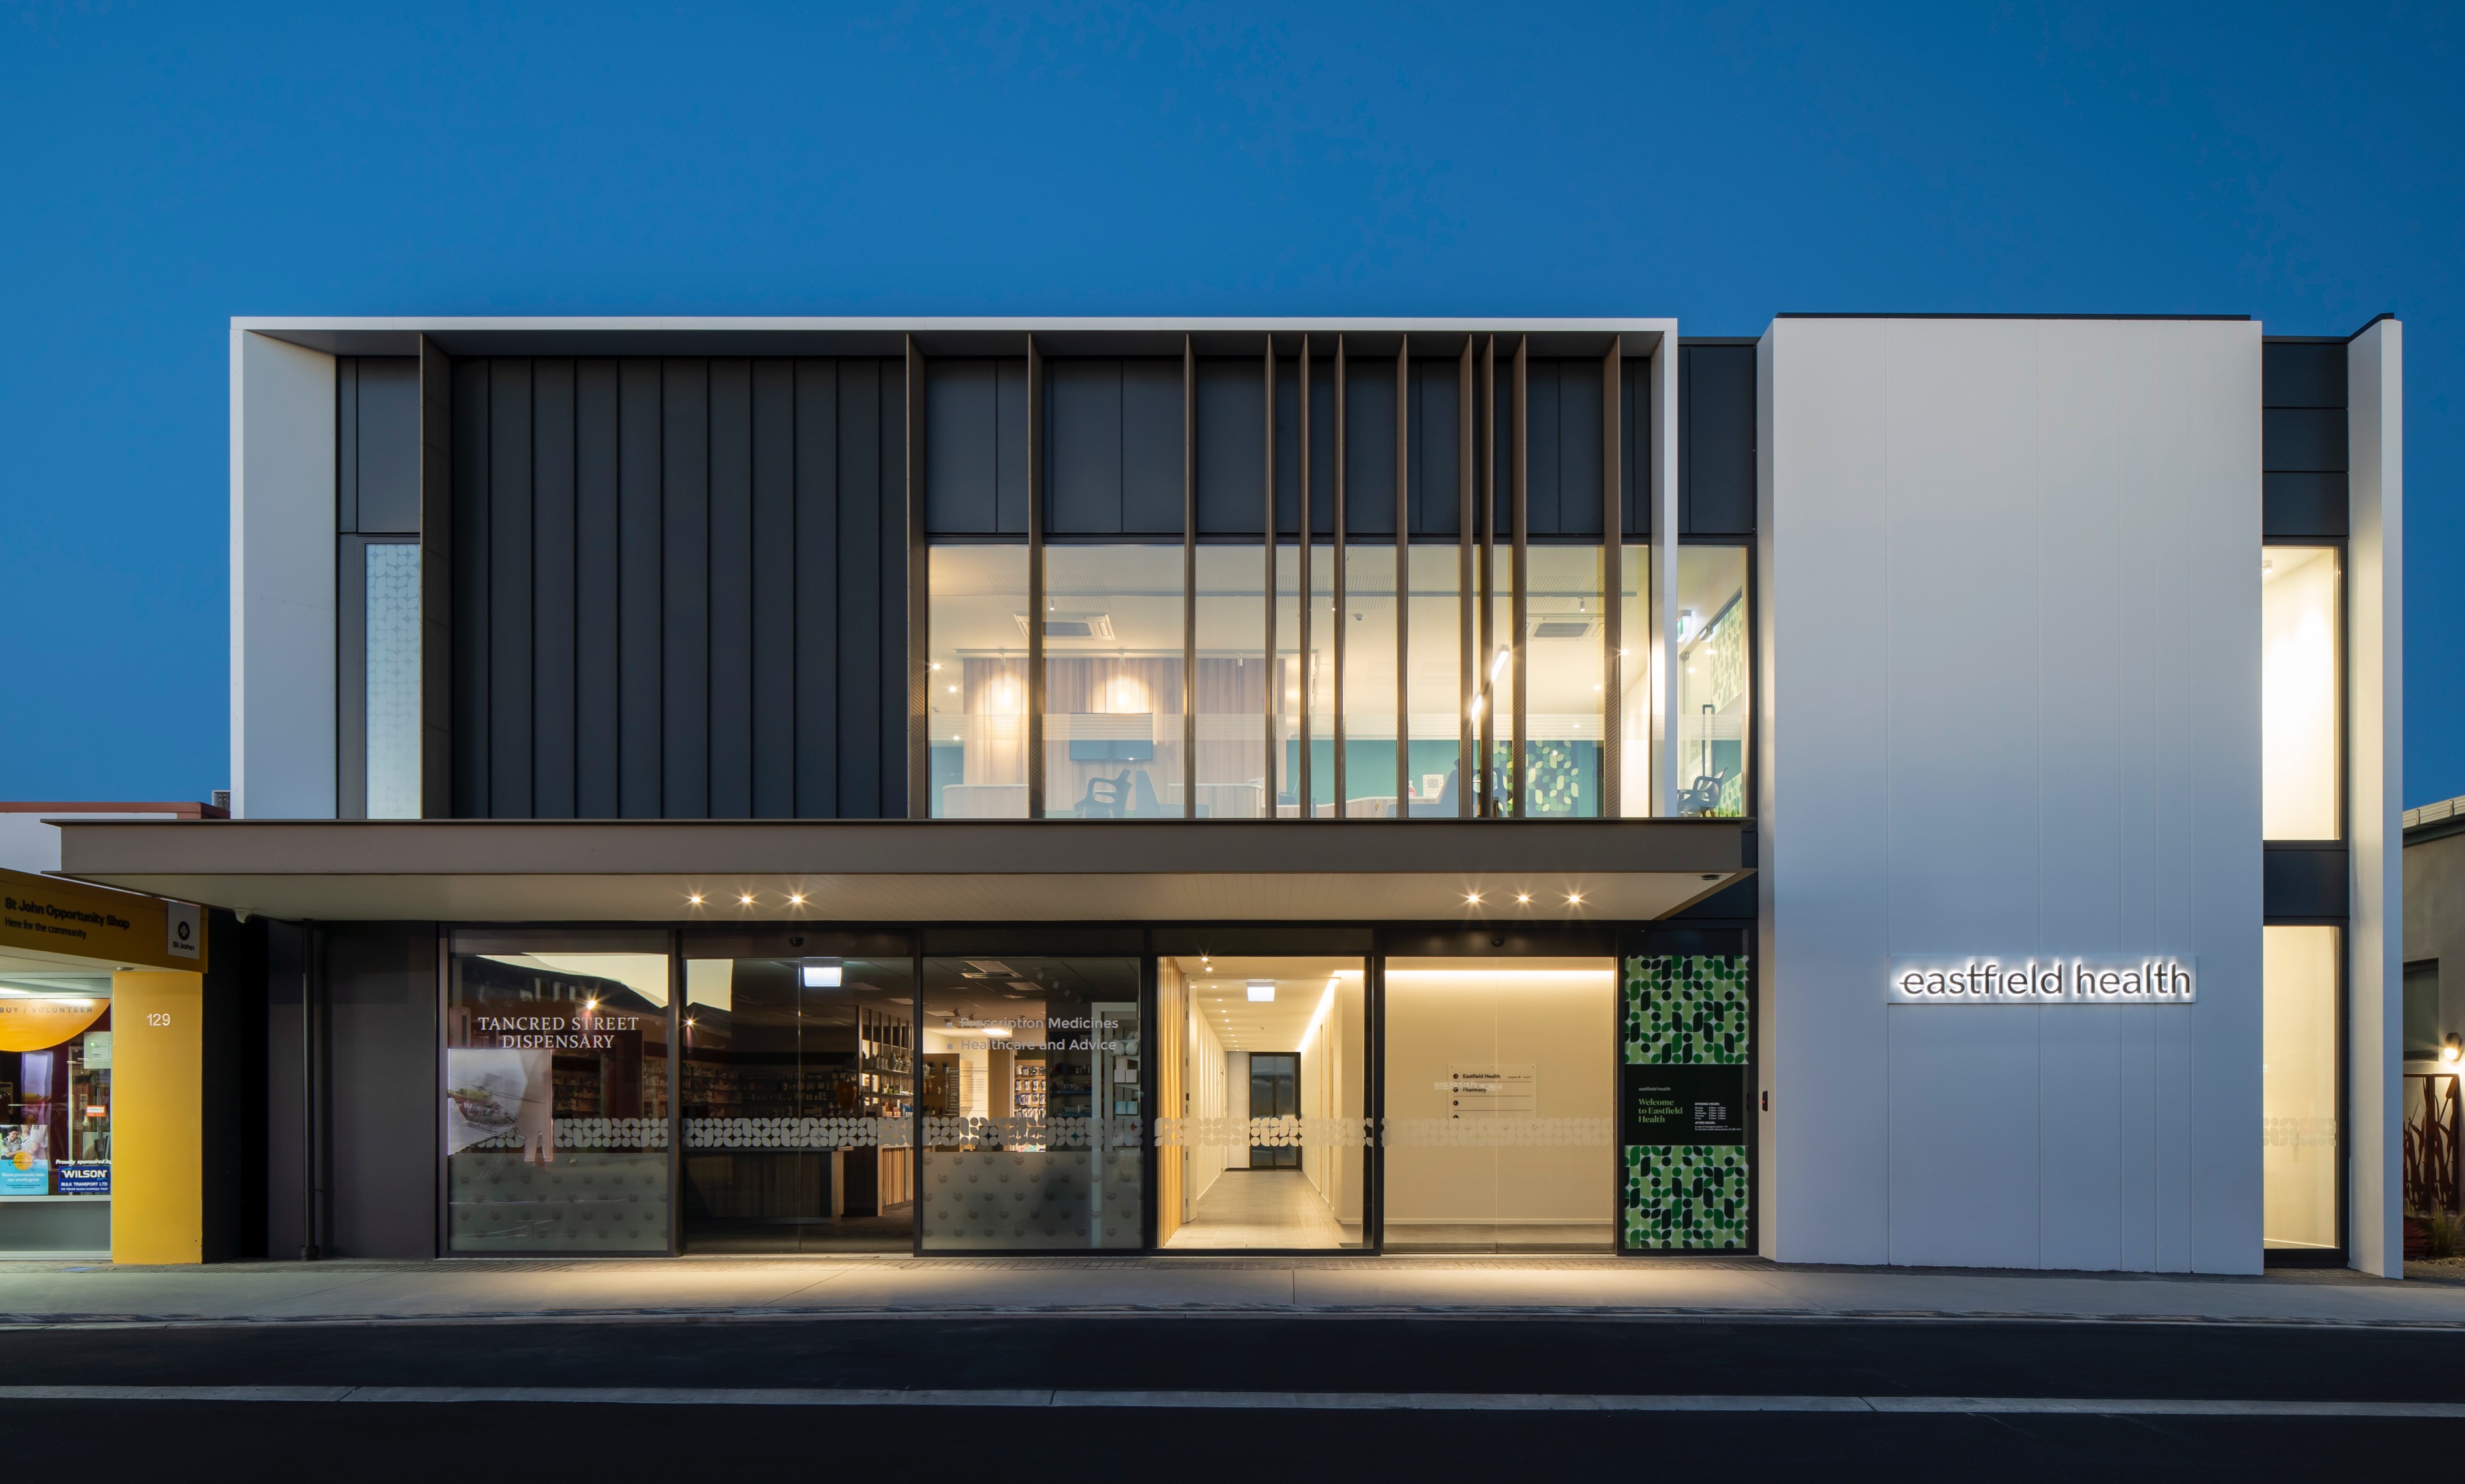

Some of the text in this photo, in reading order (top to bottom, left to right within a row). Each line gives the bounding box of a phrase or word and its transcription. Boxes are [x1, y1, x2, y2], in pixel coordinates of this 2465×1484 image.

[5, 897, 130, 930] St John Opportunity Shop
[5, 917, 87, 940] Here for the community
[181, 943, 195, 951] John
[1899, 962, 2190, 994] eastfield health
[146, 1013, 171, 1026] 129
[477, 1017, 639, 1030] TANCRED STREET
[961, 1017, 1118, 1030] Prescription Medicines
[502, 1035, 615, 1048] DISPENSARY
[961, 1039, 1116, 1050] Healthcare and Advice
[61, 1170, 108, 1178] WILSON
